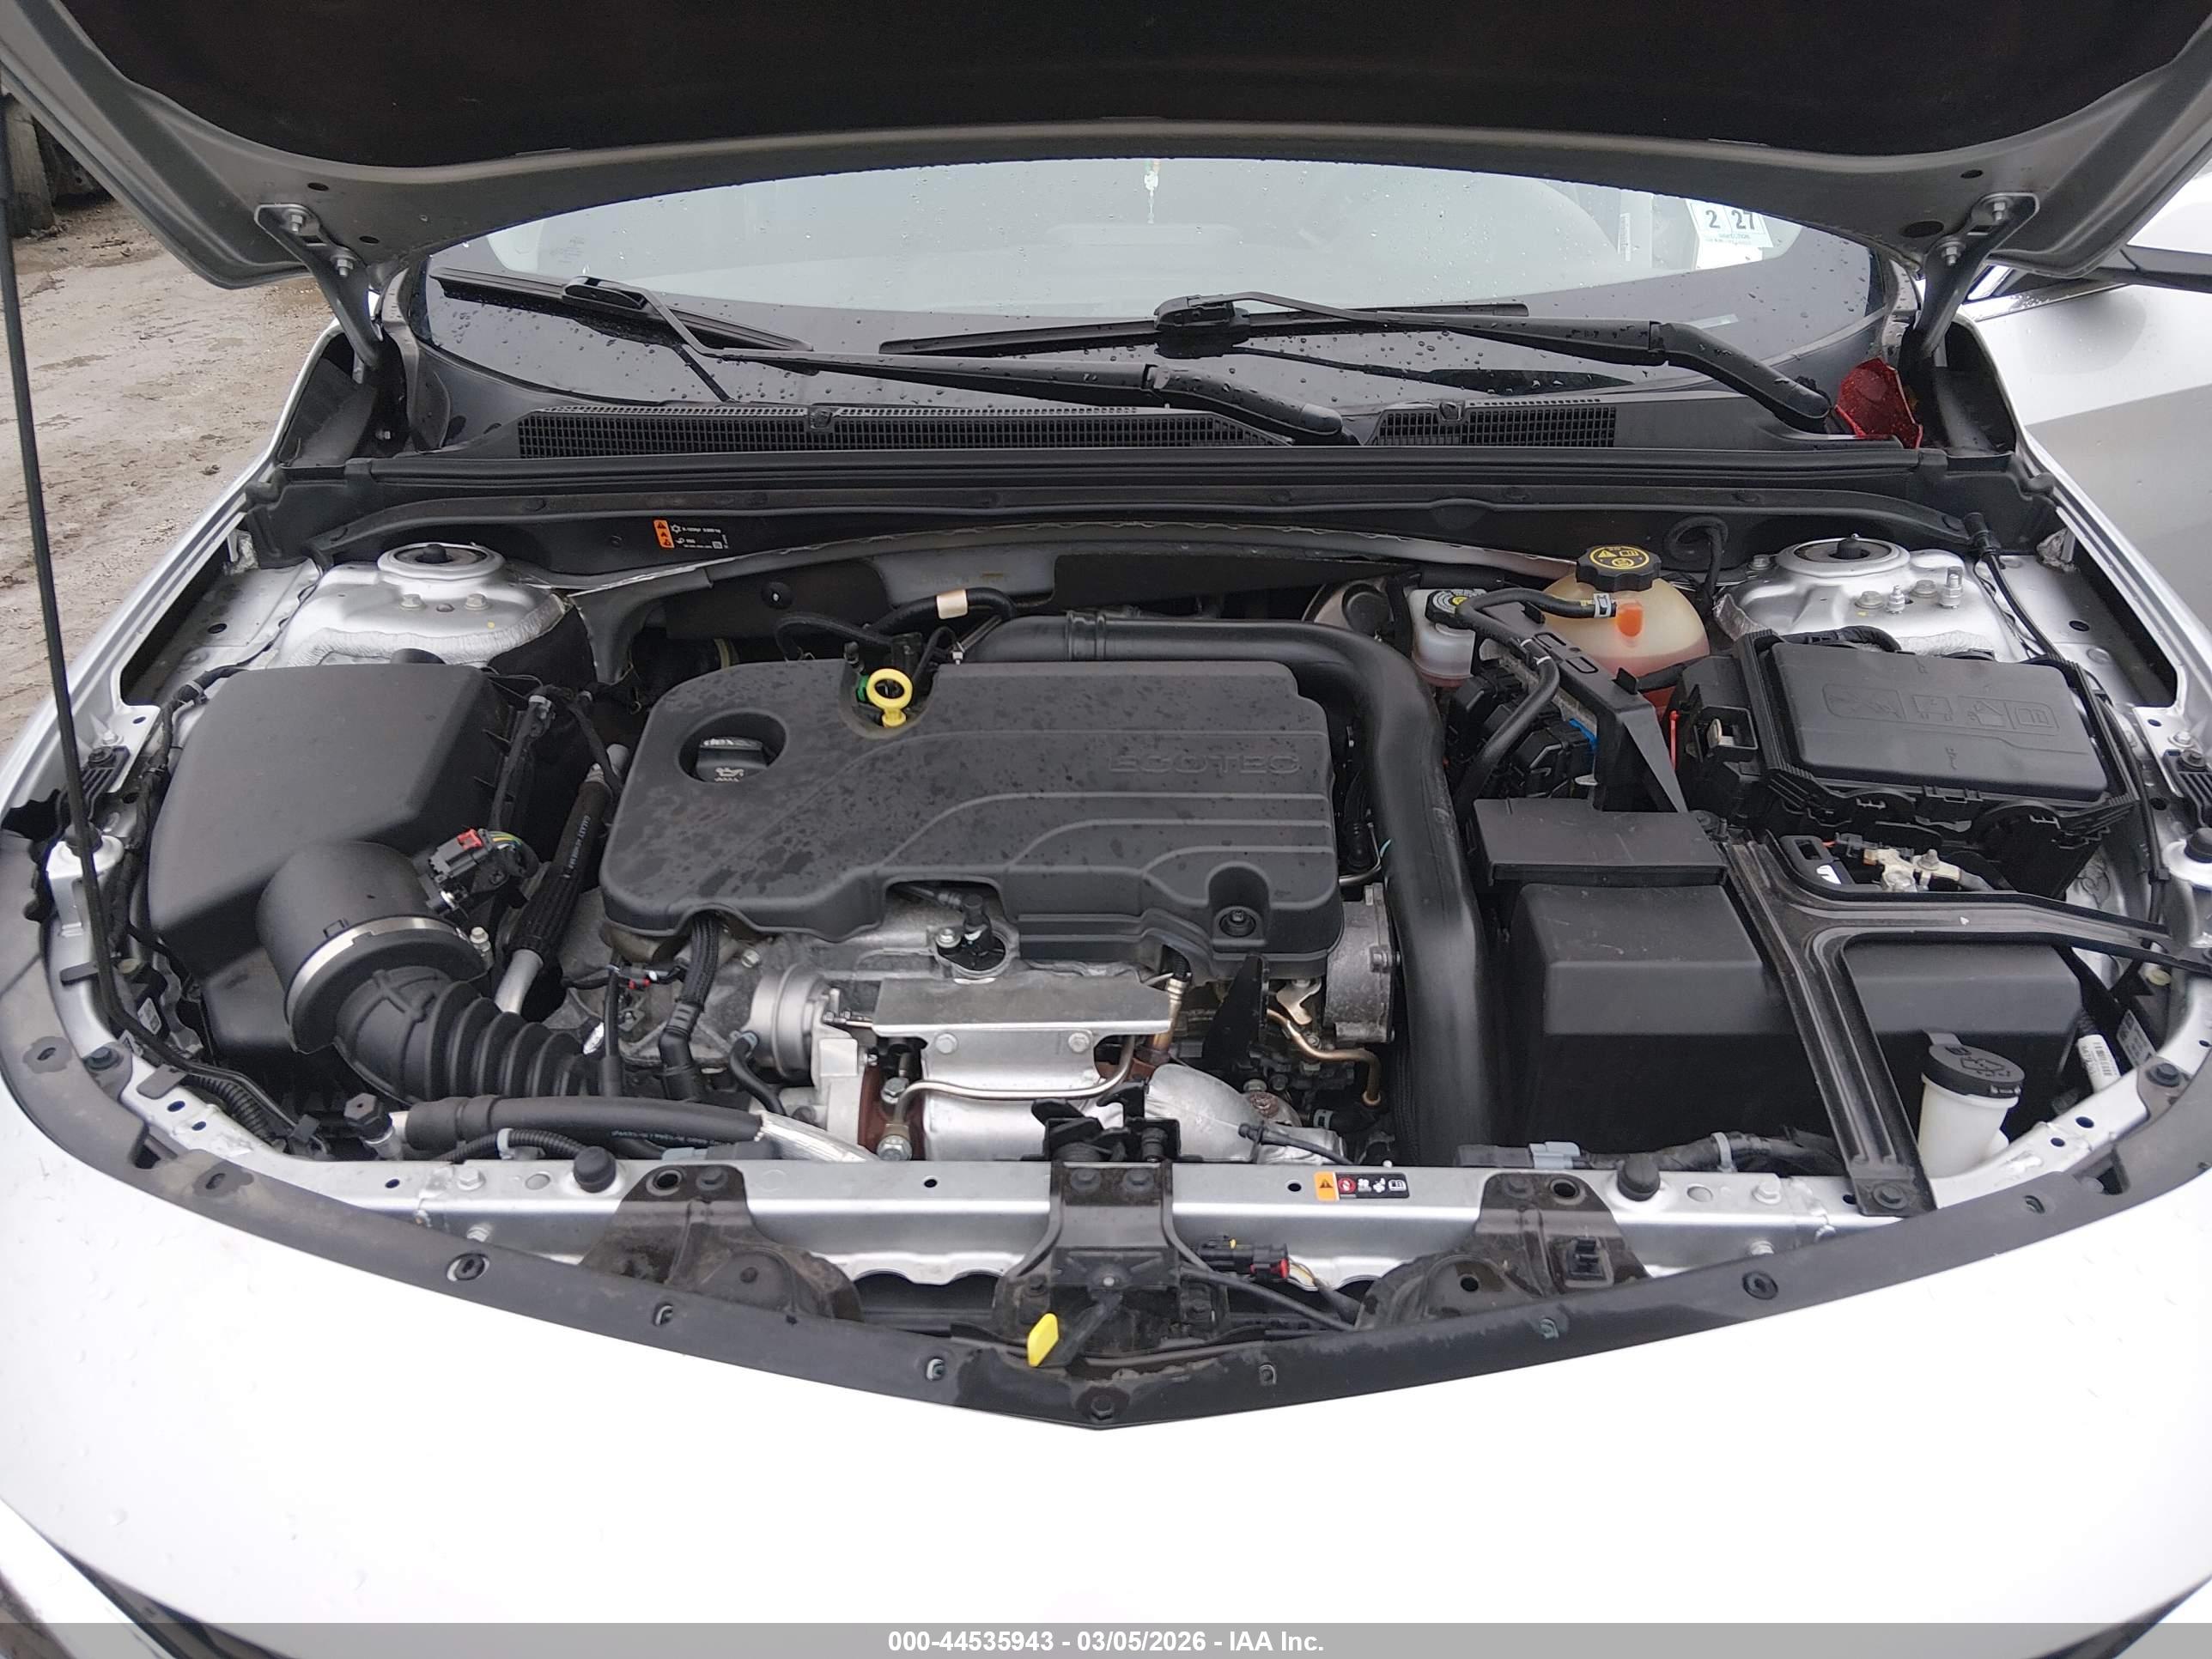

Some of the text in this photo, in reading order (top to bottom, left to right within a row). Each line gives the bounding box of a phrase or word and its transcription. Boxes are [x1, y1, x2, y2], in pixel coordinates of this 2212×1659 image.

[1705, 210, 1755, 230] 2 27
[1109, 754, 1300, 774] ECOTEC
